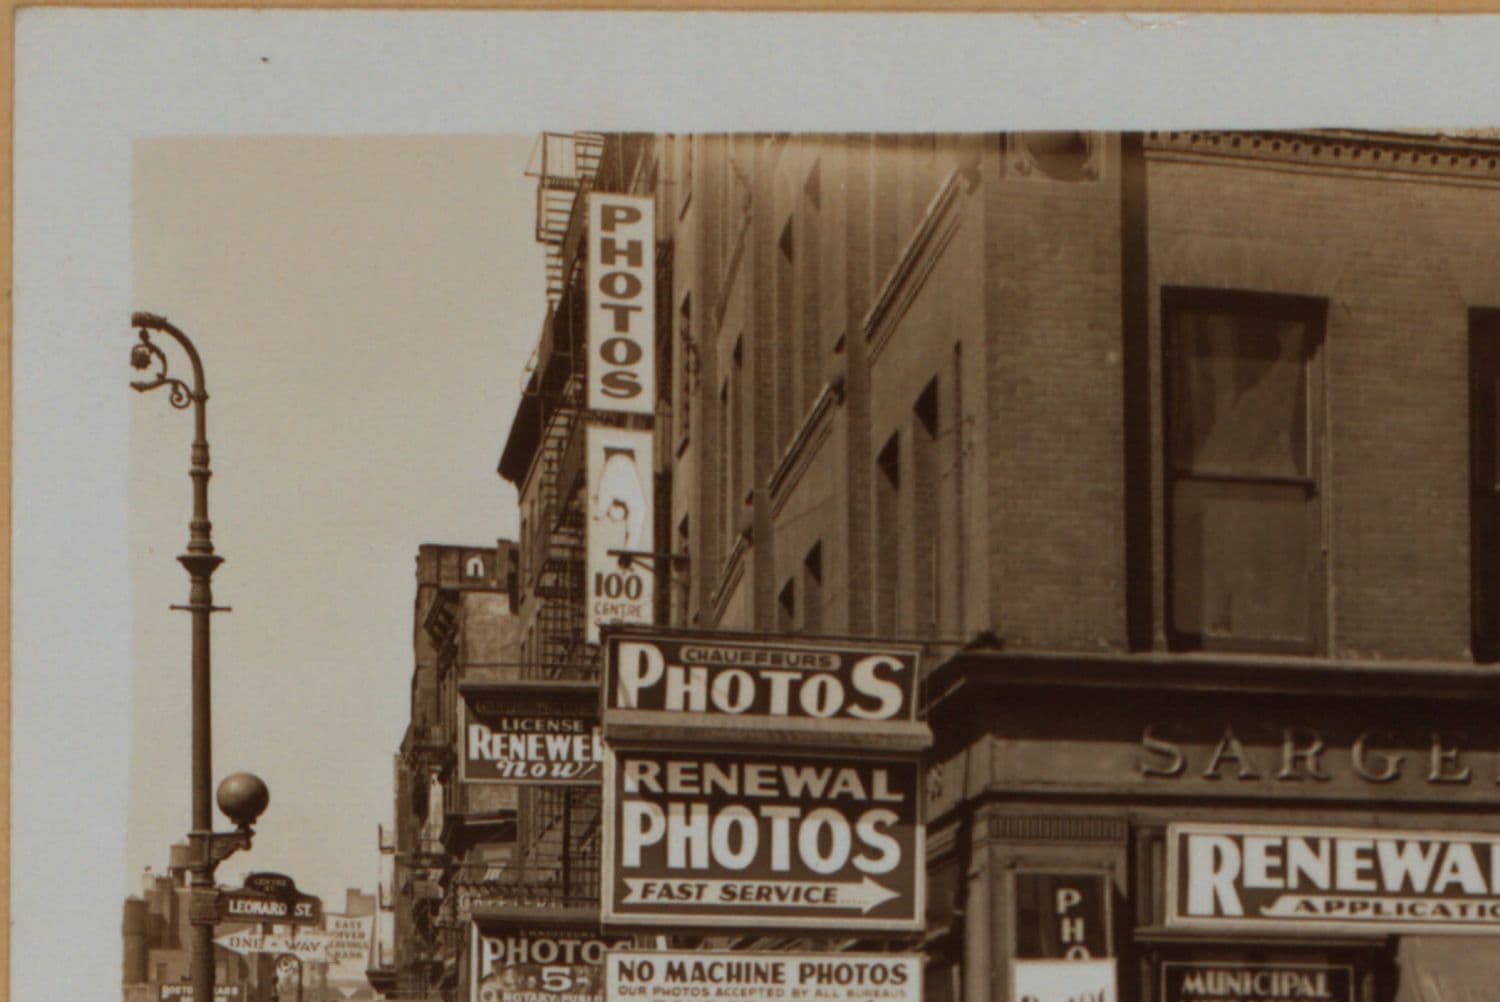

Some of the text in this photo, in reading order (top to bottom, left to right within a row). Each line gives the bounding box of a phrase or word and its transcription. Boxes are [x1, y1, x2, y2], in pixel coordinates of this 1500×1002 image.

[600, 204, 643, 399] PHOTOS
[594, 572, 643, 600] 100
[685, 649, 832, 668] CHAUFFEURS
[618, 642, 905, 720] PHOTOS
[501, 717, 584, 732] LICENSE
[624, 760, 904, 802] RENEWAL
[622, 800, 902, 875] PHOTOS
[641, 883, 838, 904] FAST SERVICE
[229, 899, 288, 917] LEONARD
[229, 936, 264, 949] ONE
[285, 938, 321, 952] WAY
[541, 966, 573, 993] 5
[618, 960, 909, 986] NO MACHINE PHOTOS
[1181, 970, 1332, 998] MUNICIPAL
[618, 985, 647, 997] OUR
[653, 986, 710, 998] PHOTOS
[716, 987, 785, 999] ACCEPTED
[791, 988, 807, 999] BY
[815, 988, 840, 999] ALL
